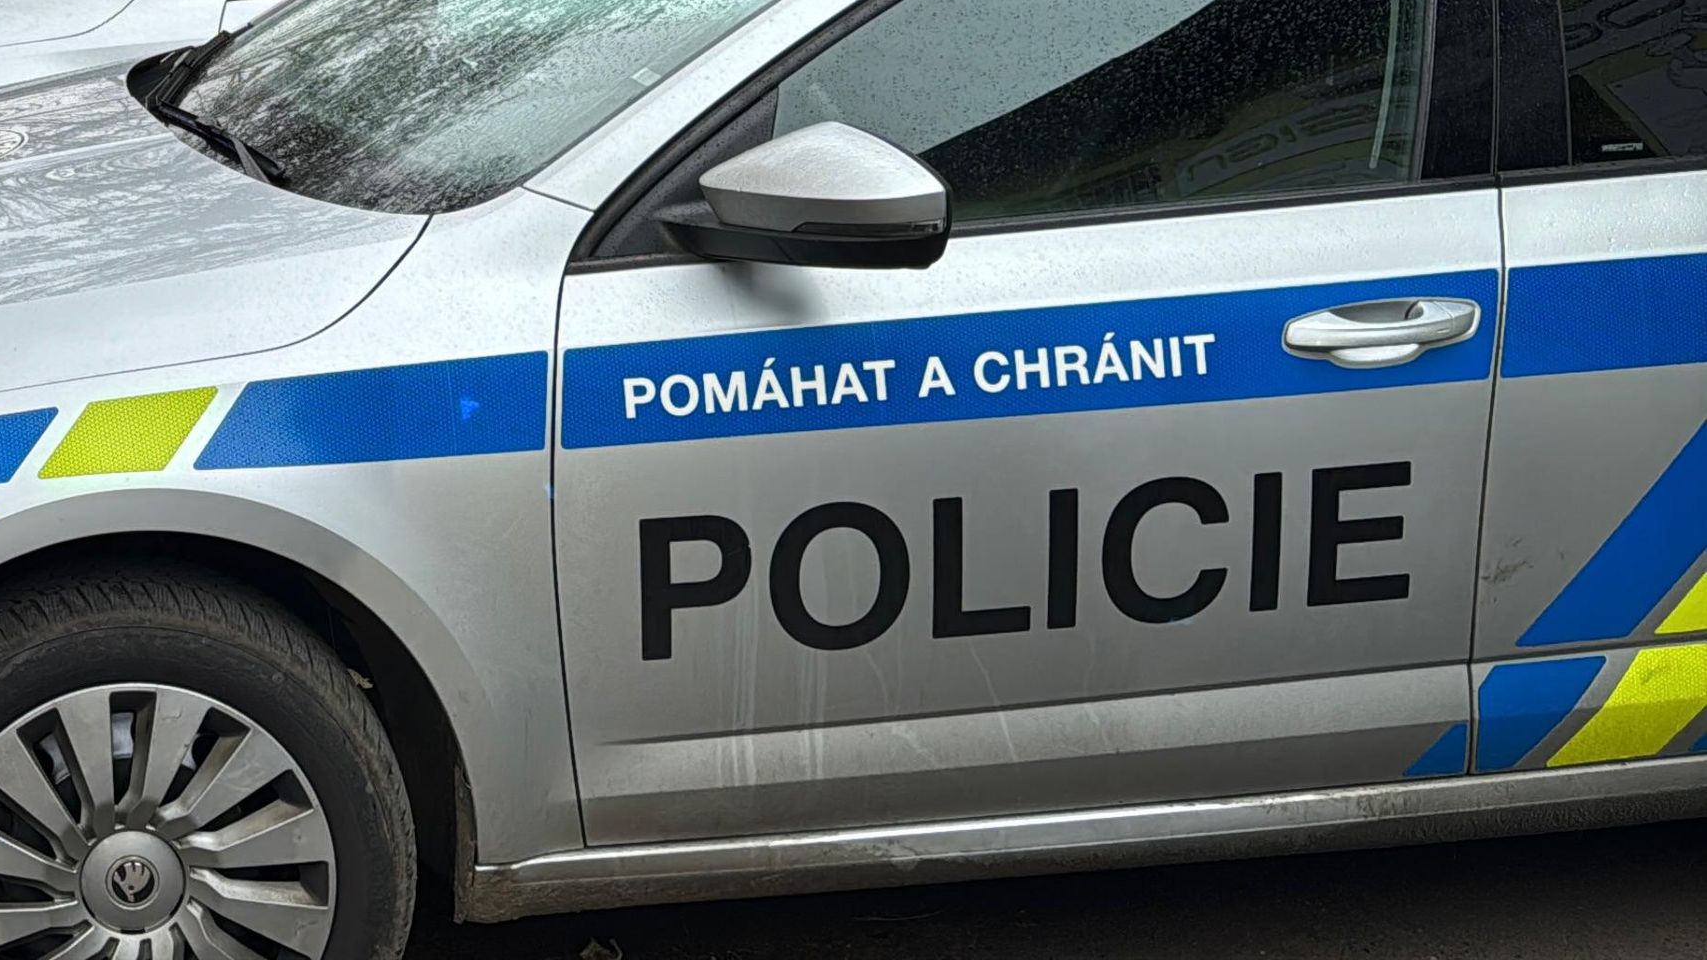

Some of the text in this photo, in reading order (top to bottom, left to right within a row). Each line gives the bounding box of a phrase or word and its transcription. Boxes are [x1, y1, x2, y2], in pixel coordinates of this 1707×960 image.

[623, 332, 1217, 420] POMÁHAT A CHRÁNIT
[638, 460, 1412, 661] POLICIE
